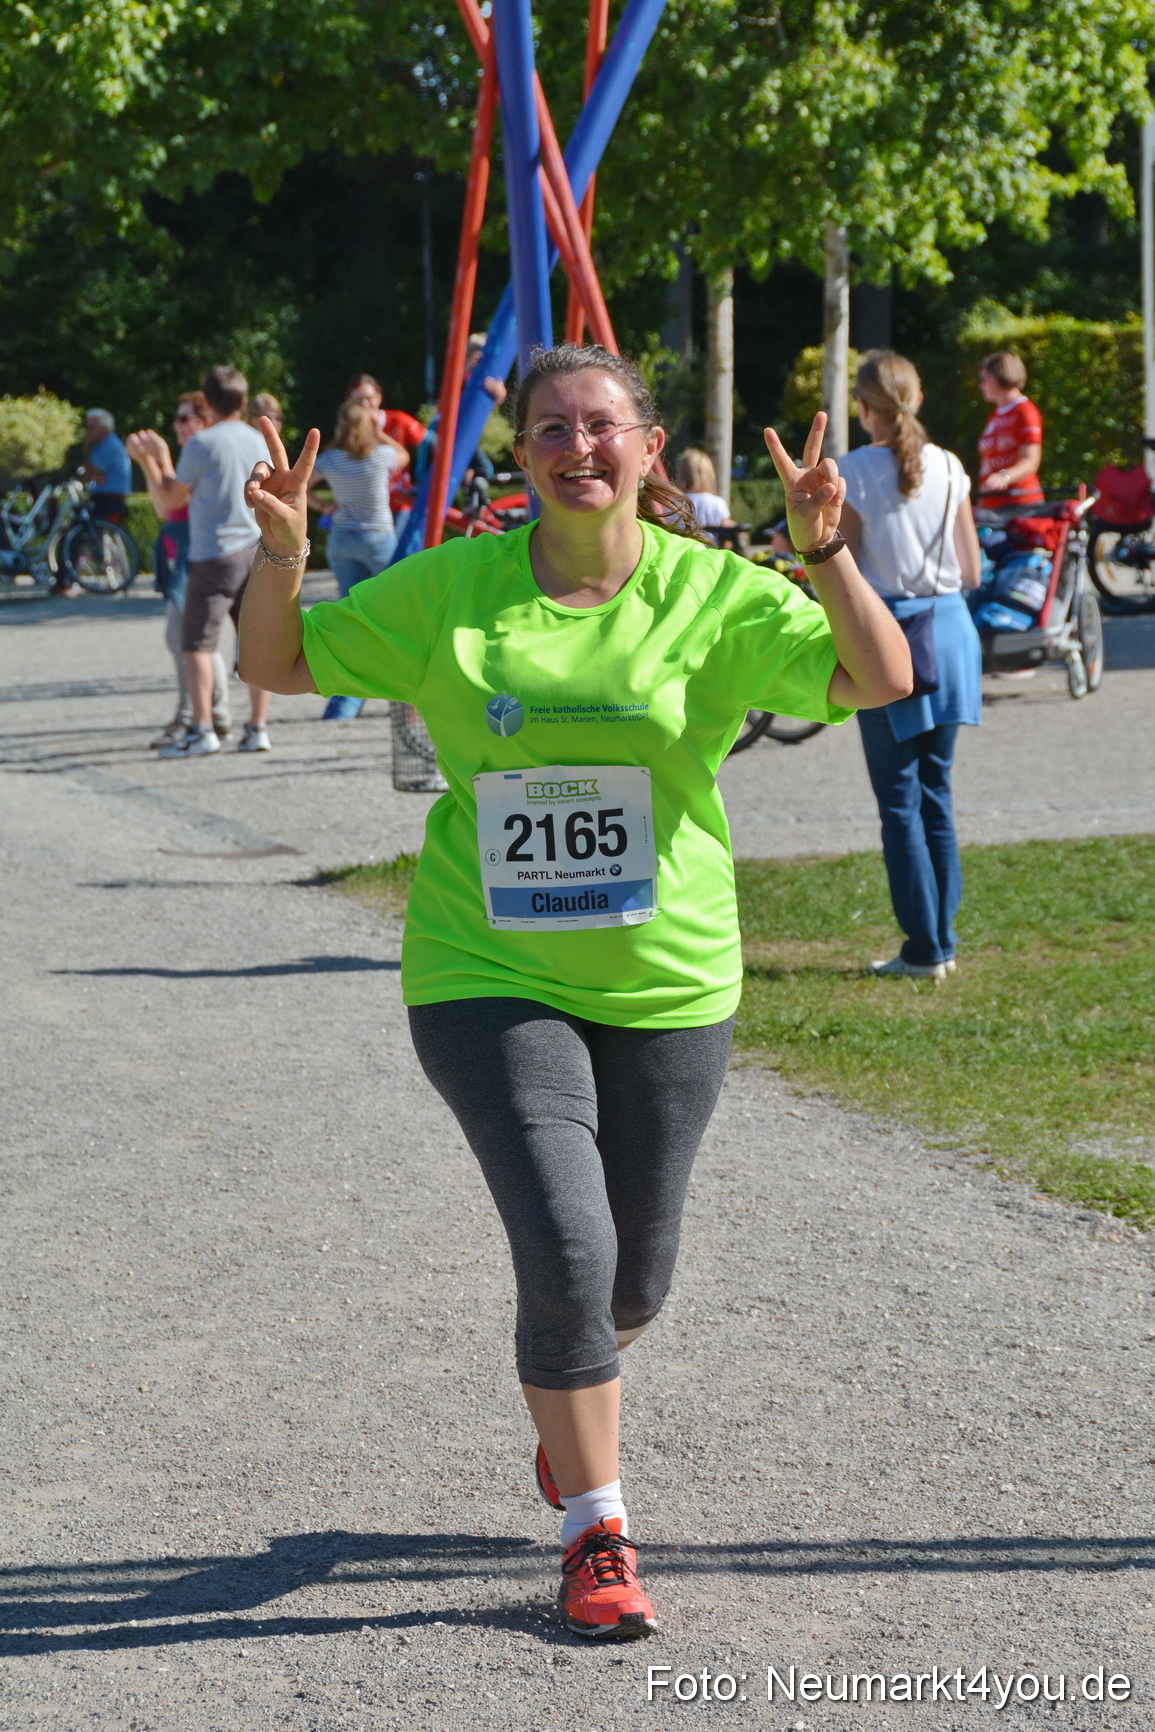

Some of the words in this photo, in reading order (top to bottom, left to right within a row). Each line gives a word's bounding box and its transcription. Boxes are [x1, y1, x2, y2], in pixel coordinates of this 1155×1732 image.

[530, 705, 550, 714] Freie
[553, 704, 600, 713] katholische
[602, 702, 649, 712] Volksschule
[561, 715, 569, 723] St.
[572, 714, 599, 723] Marien,
[525, 779, 600, 798] BOCK
[504, 808, 628, 862] 2165
[517, 870, 552, 880] PARTL
[555, 867, 606, 879] Neumarkt
[531, 890, 609, 913] Claudia
